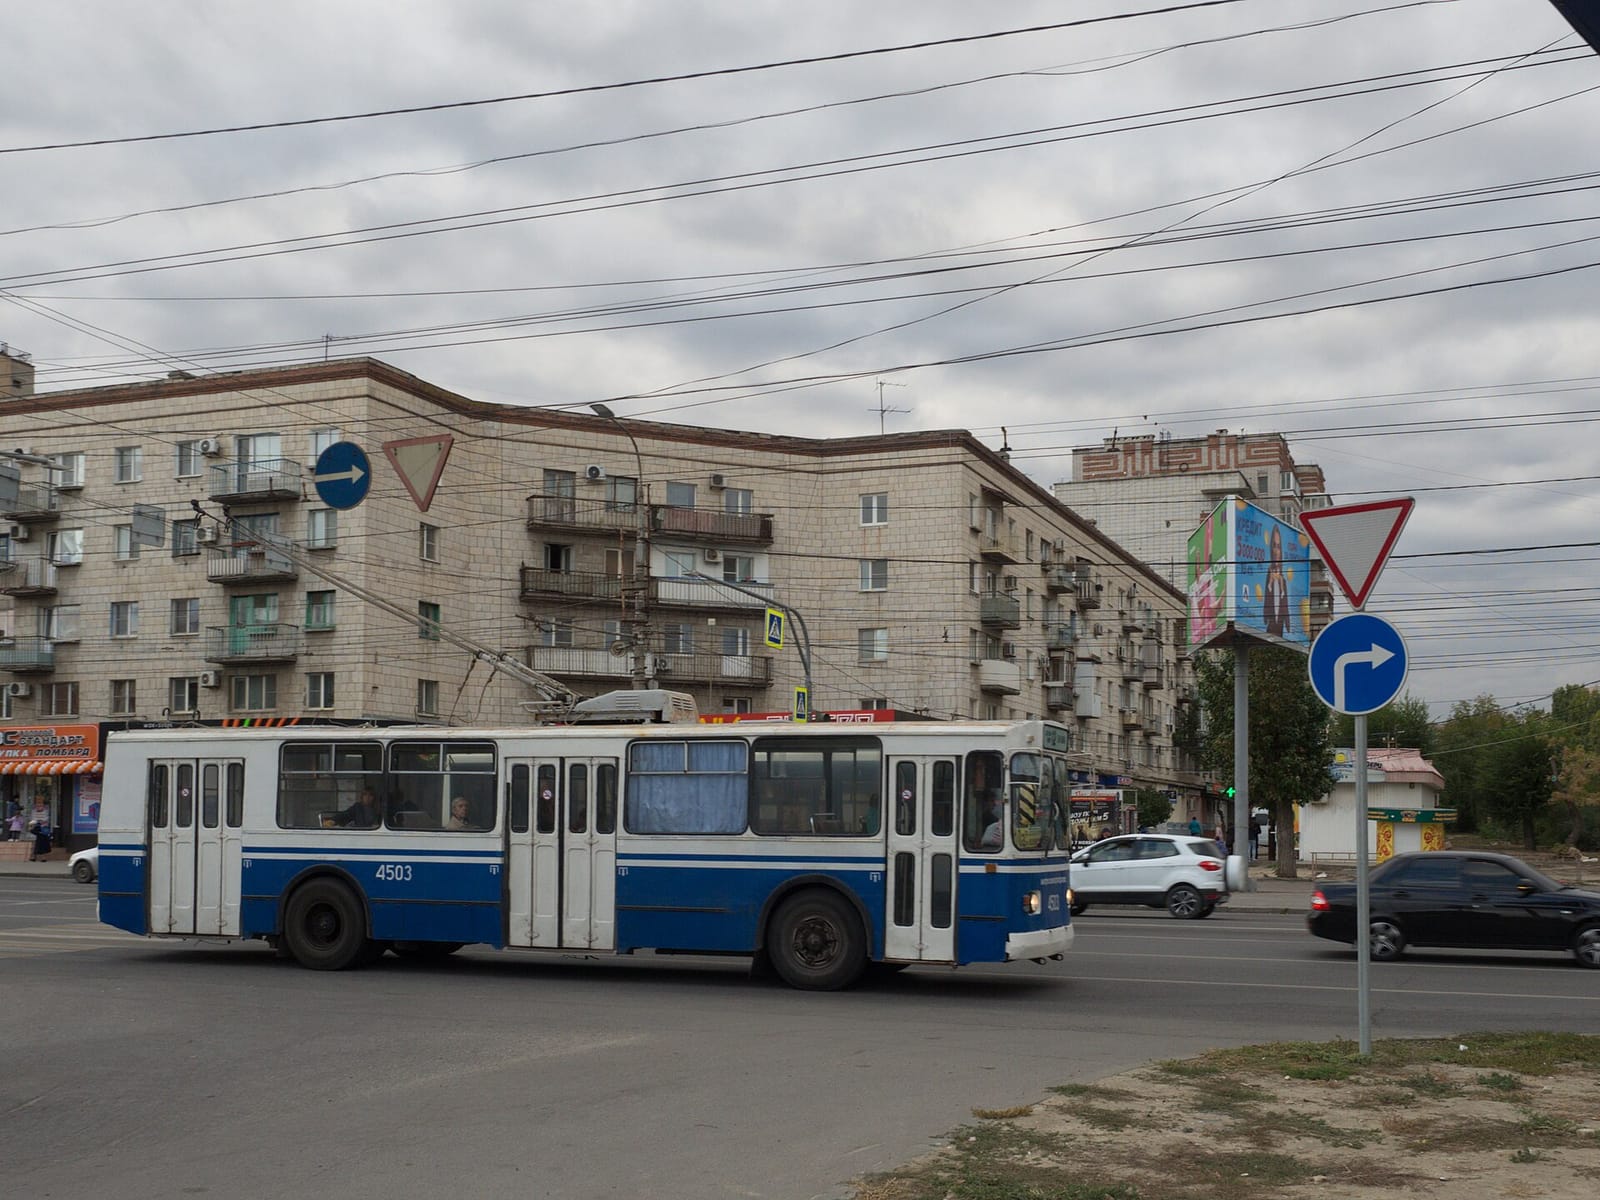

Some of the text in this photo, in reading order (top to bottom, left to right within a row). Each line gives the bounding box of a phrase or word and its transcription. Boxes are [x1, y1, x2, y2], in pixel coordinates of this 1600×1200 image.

[1237, 517, 1263, 536] КРЕДИТ
[19, 735, 84, 748] СТАНДАРТ
[36, 748, 90, 758] ЛОМБАРД
[1102, 811, 1110, 821] 5
[376, 864, 412, 881] 4503
